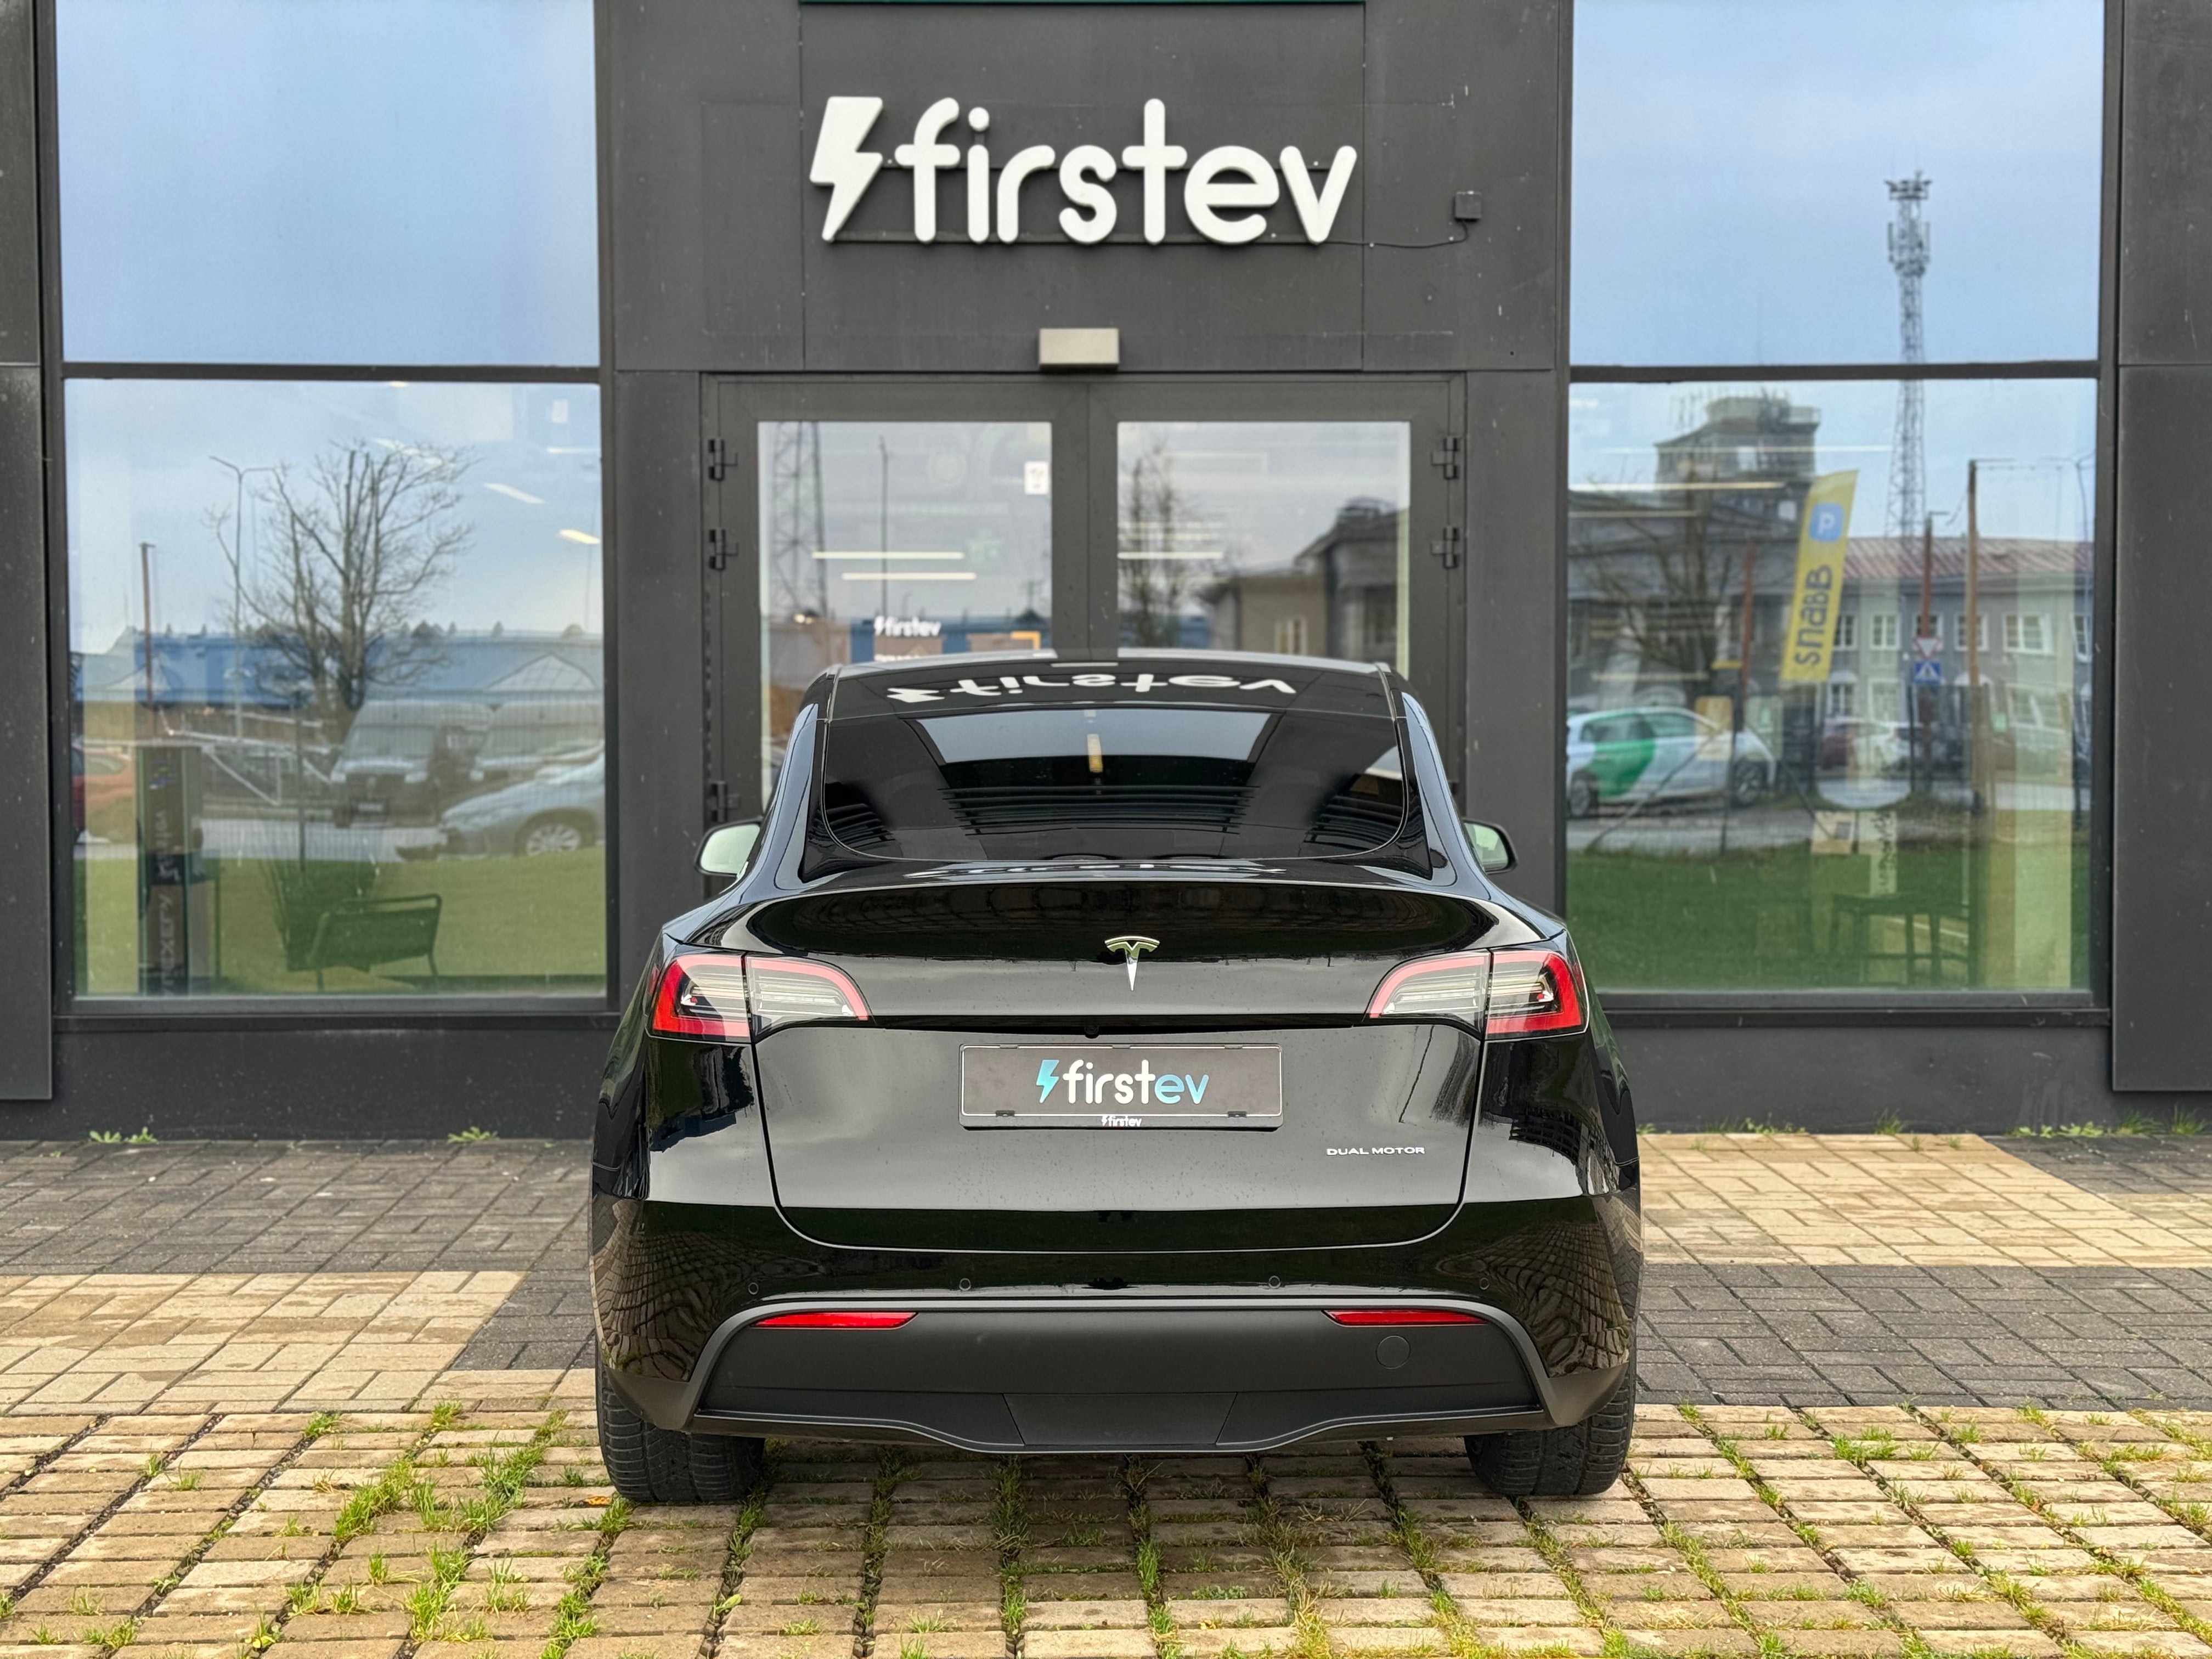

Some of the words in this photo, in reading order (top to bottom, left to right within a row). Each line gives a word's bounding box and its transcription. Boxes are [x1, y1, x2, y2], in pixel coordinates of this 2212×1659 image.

[894, 98, 1357, 244] firstev
[1817, 512, 1836, 535] P
[1062, 1059, 1210, 1104] firstev
[1107, 1115, 1142, 1127] firstev
[1327, 1148, 1369, 1156] DUAL
